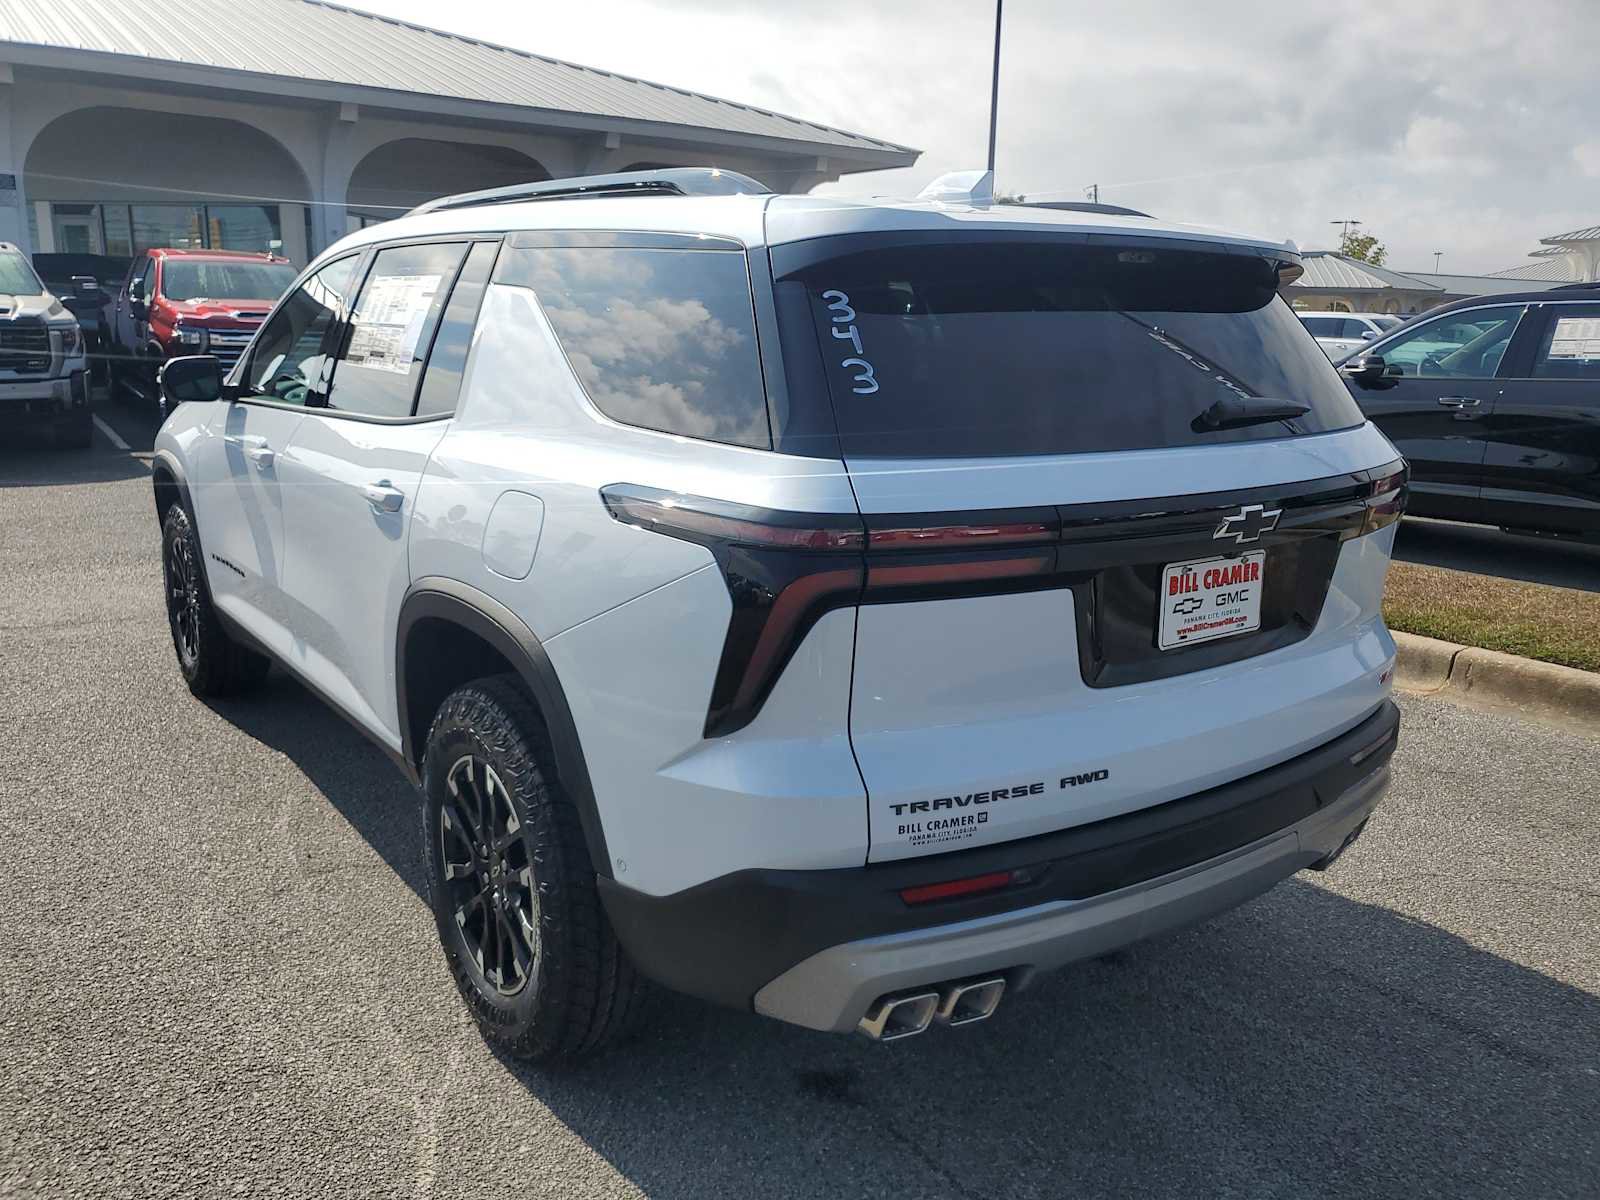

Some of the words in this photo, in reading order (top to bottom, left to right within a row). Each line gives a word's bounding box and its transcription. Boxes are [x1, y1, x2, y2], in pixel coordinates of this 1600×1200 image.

[821, 289, 879, 394] 343
[1169, 573, 1199, 596] BILL
[1203, 562, 1259, 590] CRAMER
[1215, 589, 1249, 606] GMC
[1184, 615, 1206, 625] PANAMA
[1221, 608, 1241, 618] FLORIDA
[889, 782, 1045, 816] TRAVERSE
[1060, 769, 1109, 789] AWD
[898, 822, 922, 835] BILL
[926, 815, 974, 831] CRAMER
[909, 832, 936, 841] PANAMA
